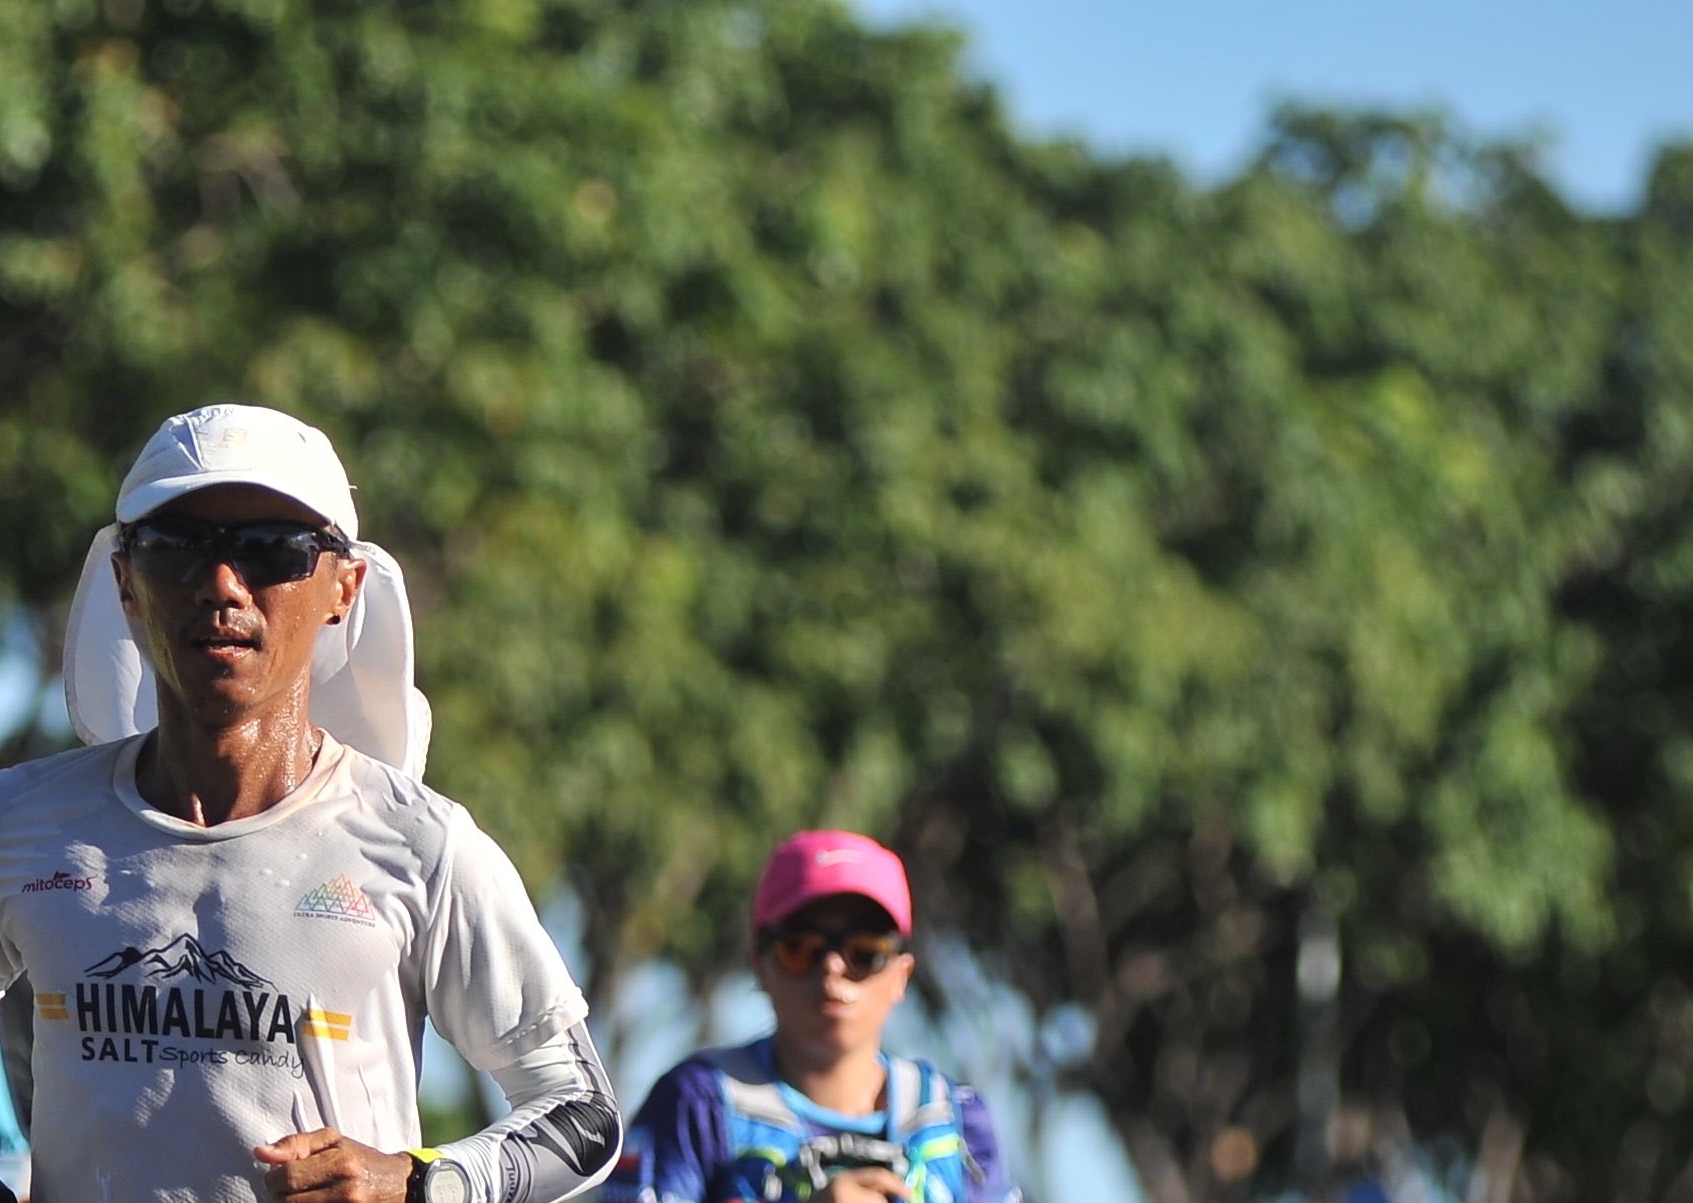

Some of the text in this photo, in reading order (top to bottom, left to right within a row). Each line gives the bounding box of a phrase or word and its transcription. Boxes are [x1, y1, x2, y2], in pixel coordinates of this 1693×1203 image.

[21, 873, 98, 893] mitoceps
[76, 982, 295, 1044] HIMALAYA
[82, 1036, 159, 1064] SALT
[159, 1046, 228, 1068] Sports
